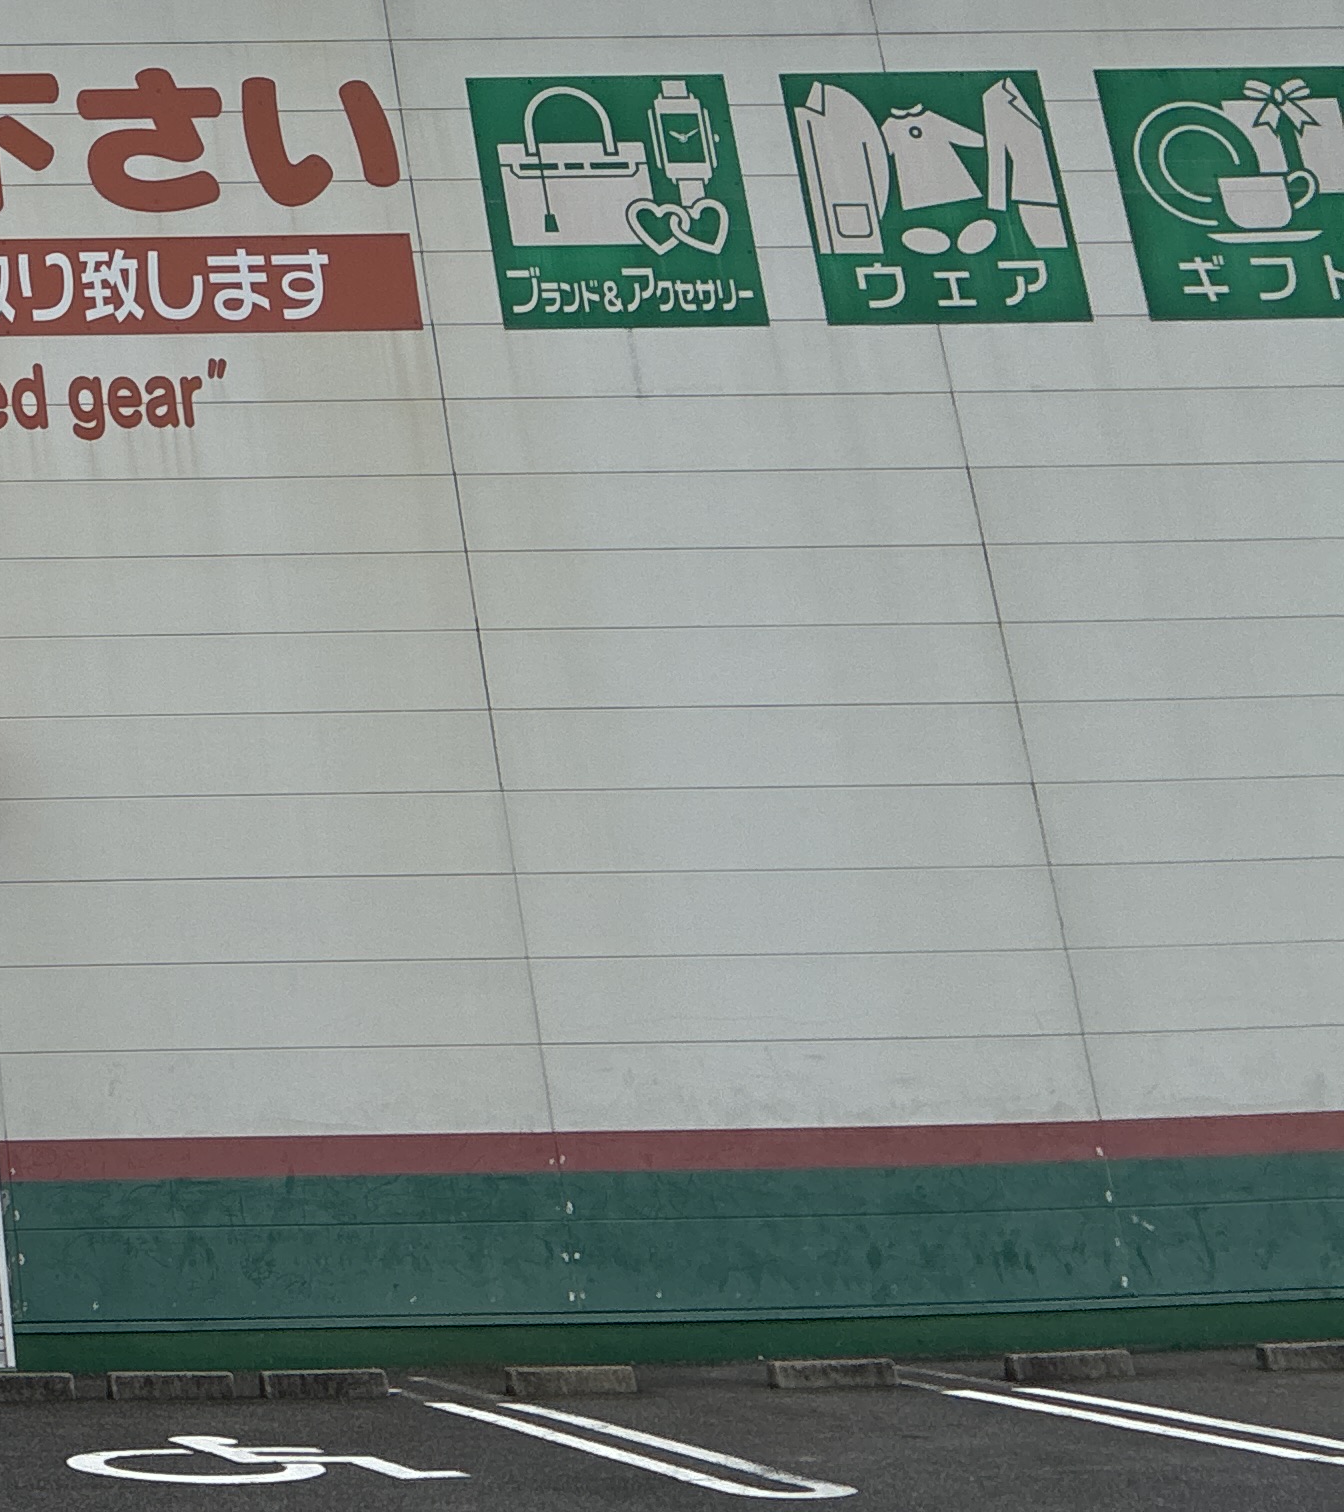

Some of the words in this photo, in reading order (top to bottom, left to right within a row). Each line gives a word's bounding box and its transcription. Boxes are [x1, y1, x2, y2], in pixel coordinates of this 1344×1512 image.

[505, 267, 755, 314] ブランド&アクセサリー
